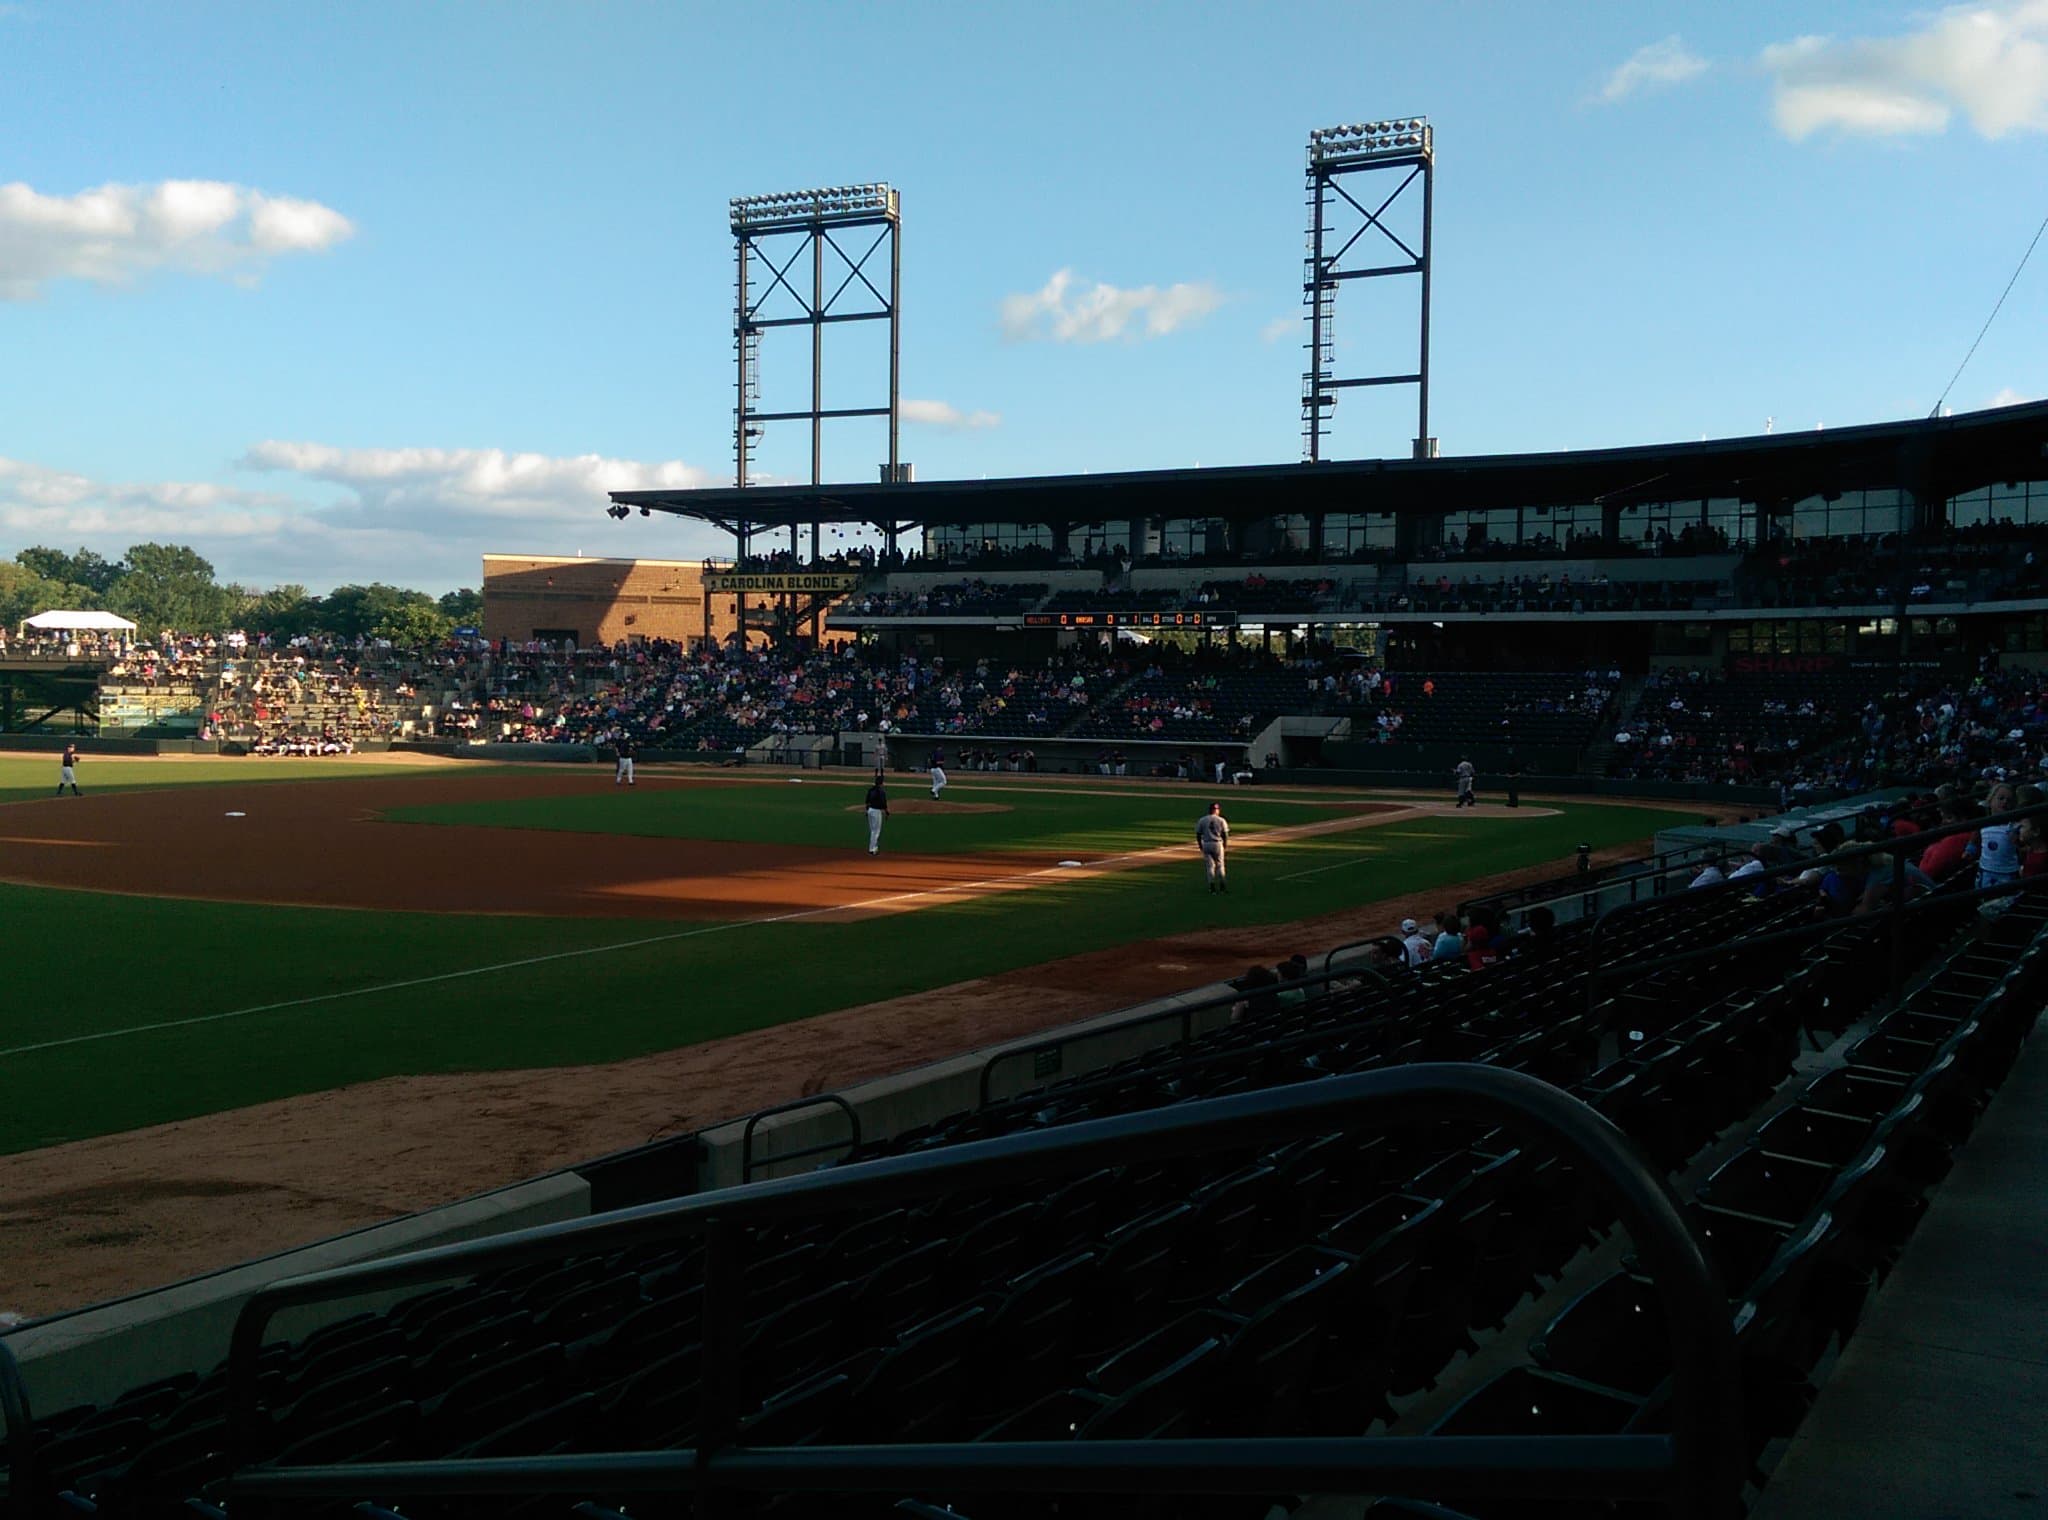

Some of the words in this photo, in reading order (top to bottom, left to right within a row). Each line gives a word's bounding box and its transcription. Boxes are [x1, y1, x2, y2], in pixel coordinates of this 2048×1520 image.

[721, 577, 784, 589] CAROLINA
[787, 576, 838, 588] BLONDE
[1060, 614, 1067, 624] 0
[1107, 614, 1114, 624] 0
[1153, 613, 1160, 624] 0
[1176, 613, 1183, 624] 0
[1735, 656, 1834, 672] SHARP
